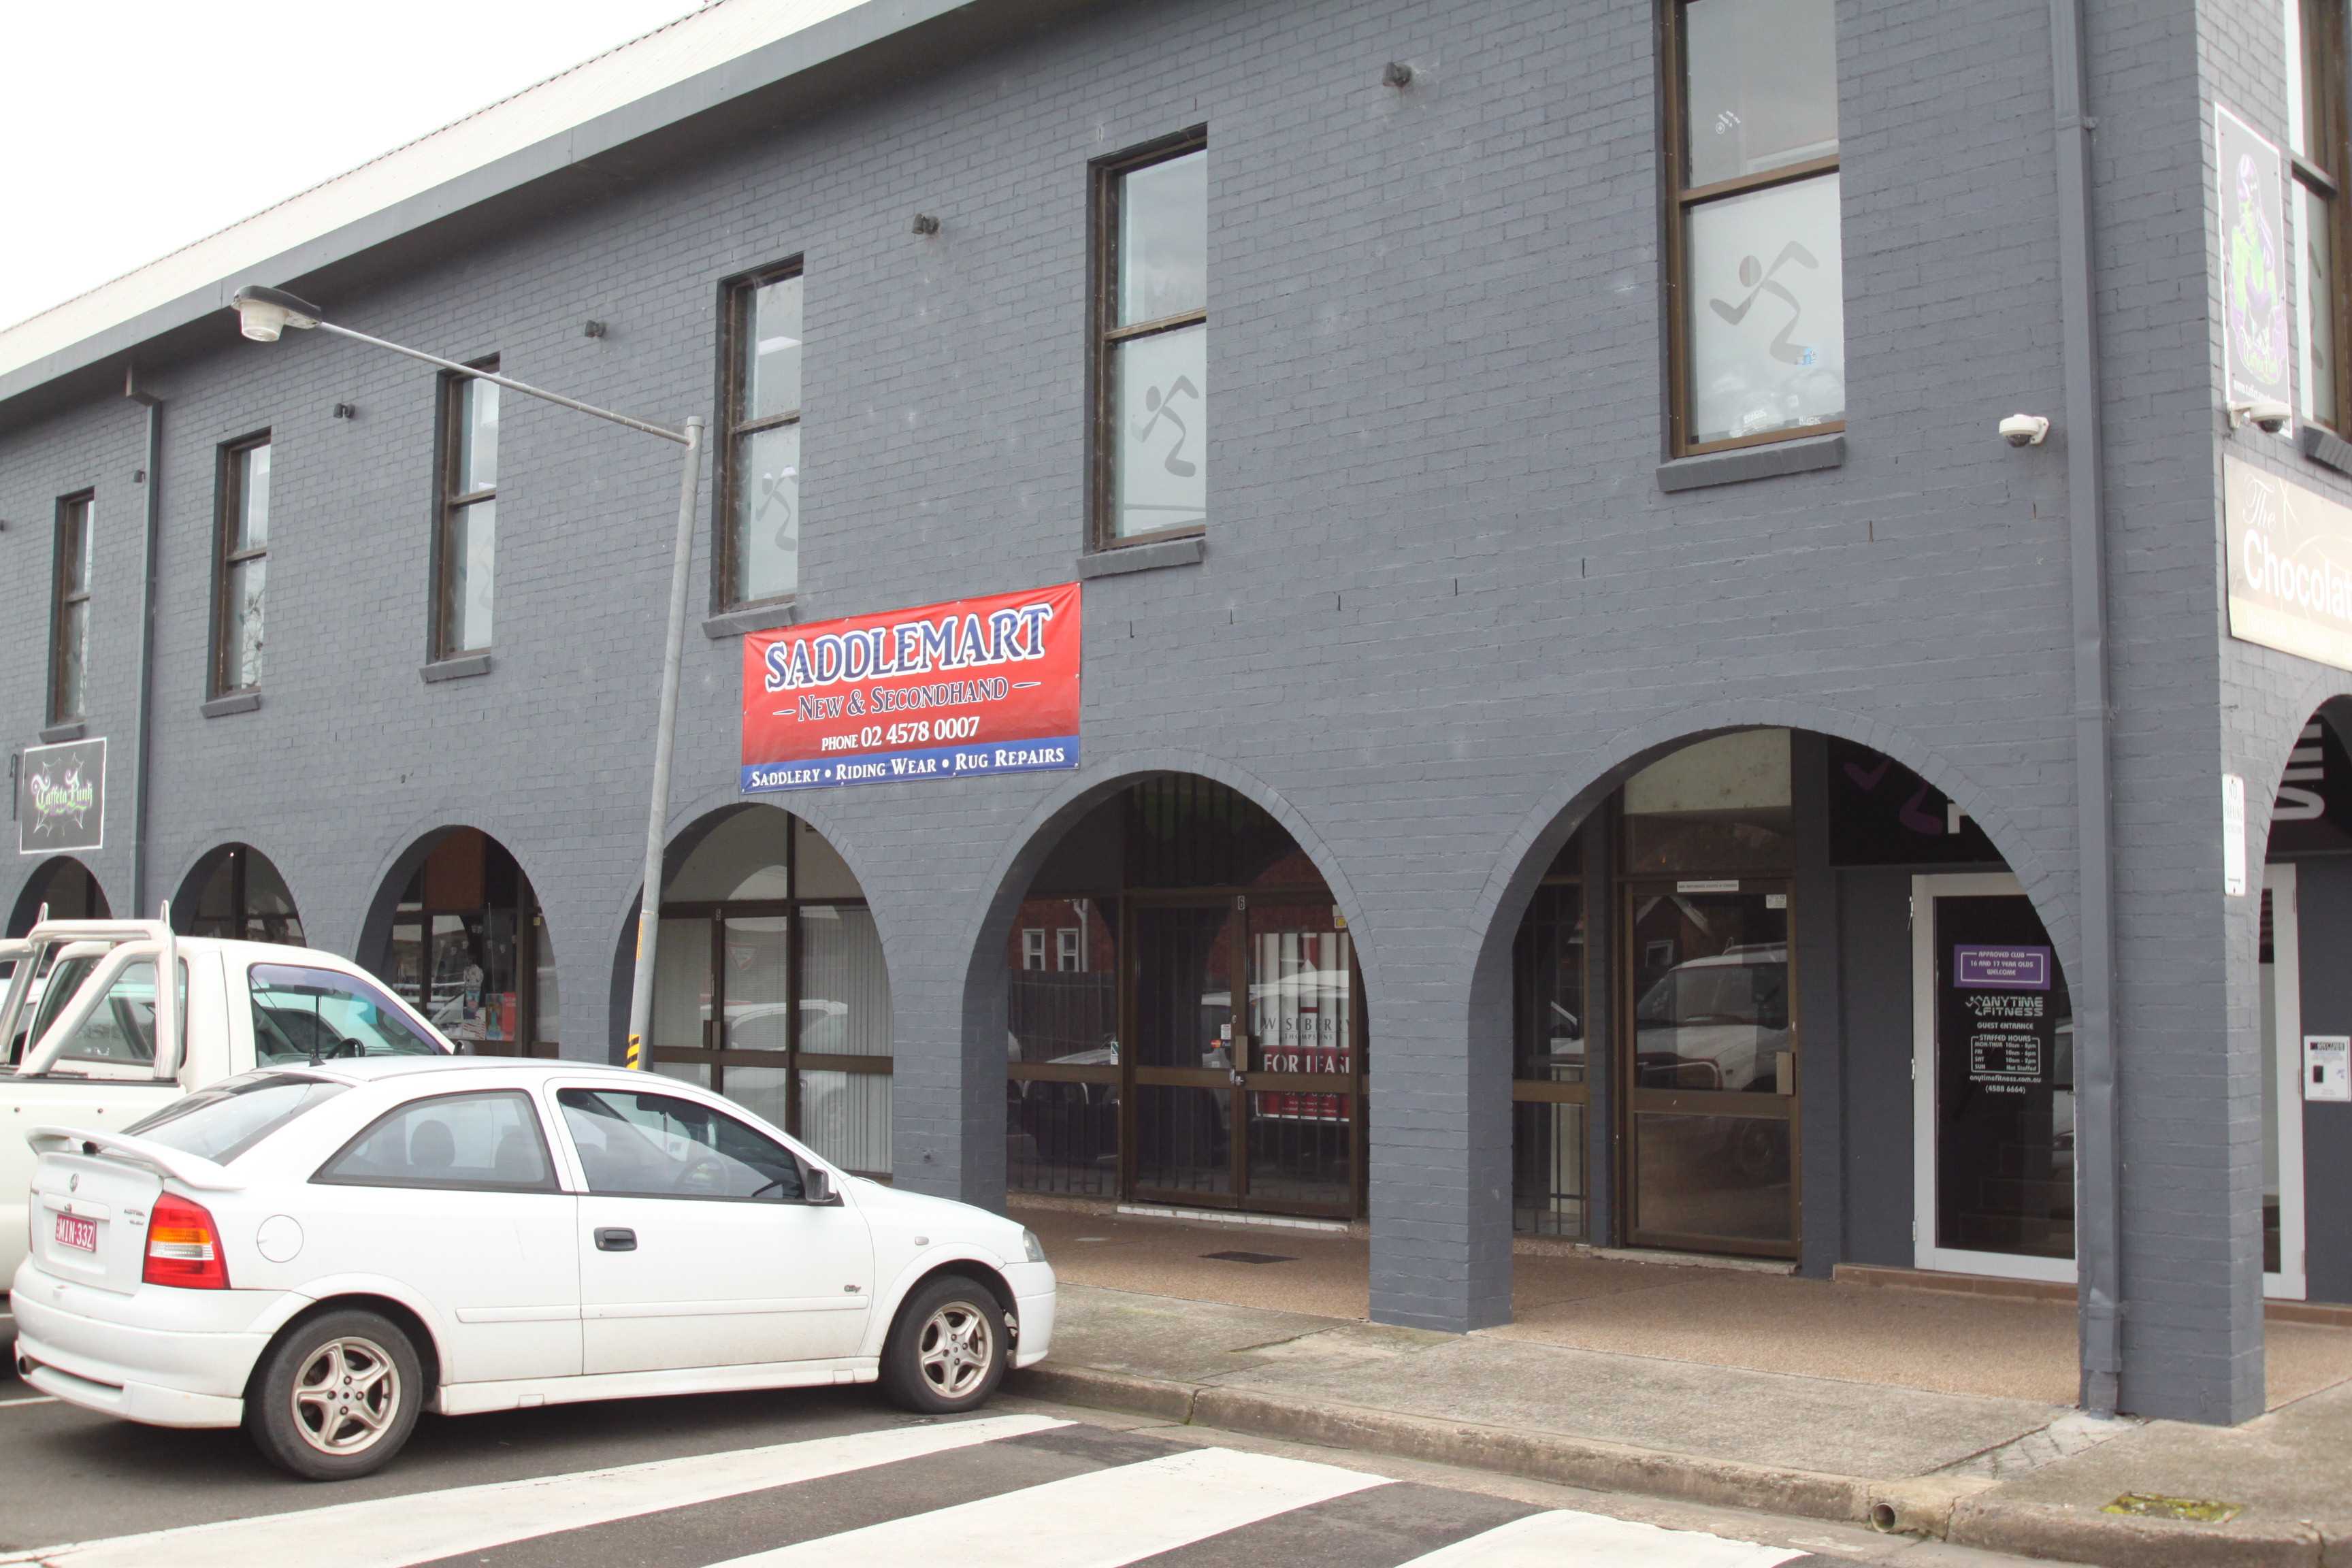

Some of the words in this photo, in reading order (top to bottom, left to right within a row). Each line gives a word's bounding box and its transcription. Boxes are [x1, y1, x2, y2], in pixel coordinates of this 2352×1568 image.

[2242, 474, 2276, 532] The
[766, 603, 1053, 692] SADDLEMART
[798, 694, 844, 721] NEW
[847, 689, 866, 716] &
[871, 676, 1009, 713] SECONDHAND
[821, 734, 858, 751] PHONE
[861, 726, 882, 747] 02
[886, 721, 929, 744] 4578
[934, 717, 980, 740] 0007
[752, 768, 820, 787] SADDLERY
[836, 763, 886, 781] RIDING
[890, 757, 936, 775] WEAR
[956, 753, 988, 770] RUG
[995, 747, 1064, 767] REPAIRS
[1982, 996, 2043, 1007] ANYTIME
[1983, 1007, 2043, 1017] FITNESS
[1264, 1054, 1299, 1073] FOR
[1970, 1075, 2042, 1083] anytimefitness.com.au
